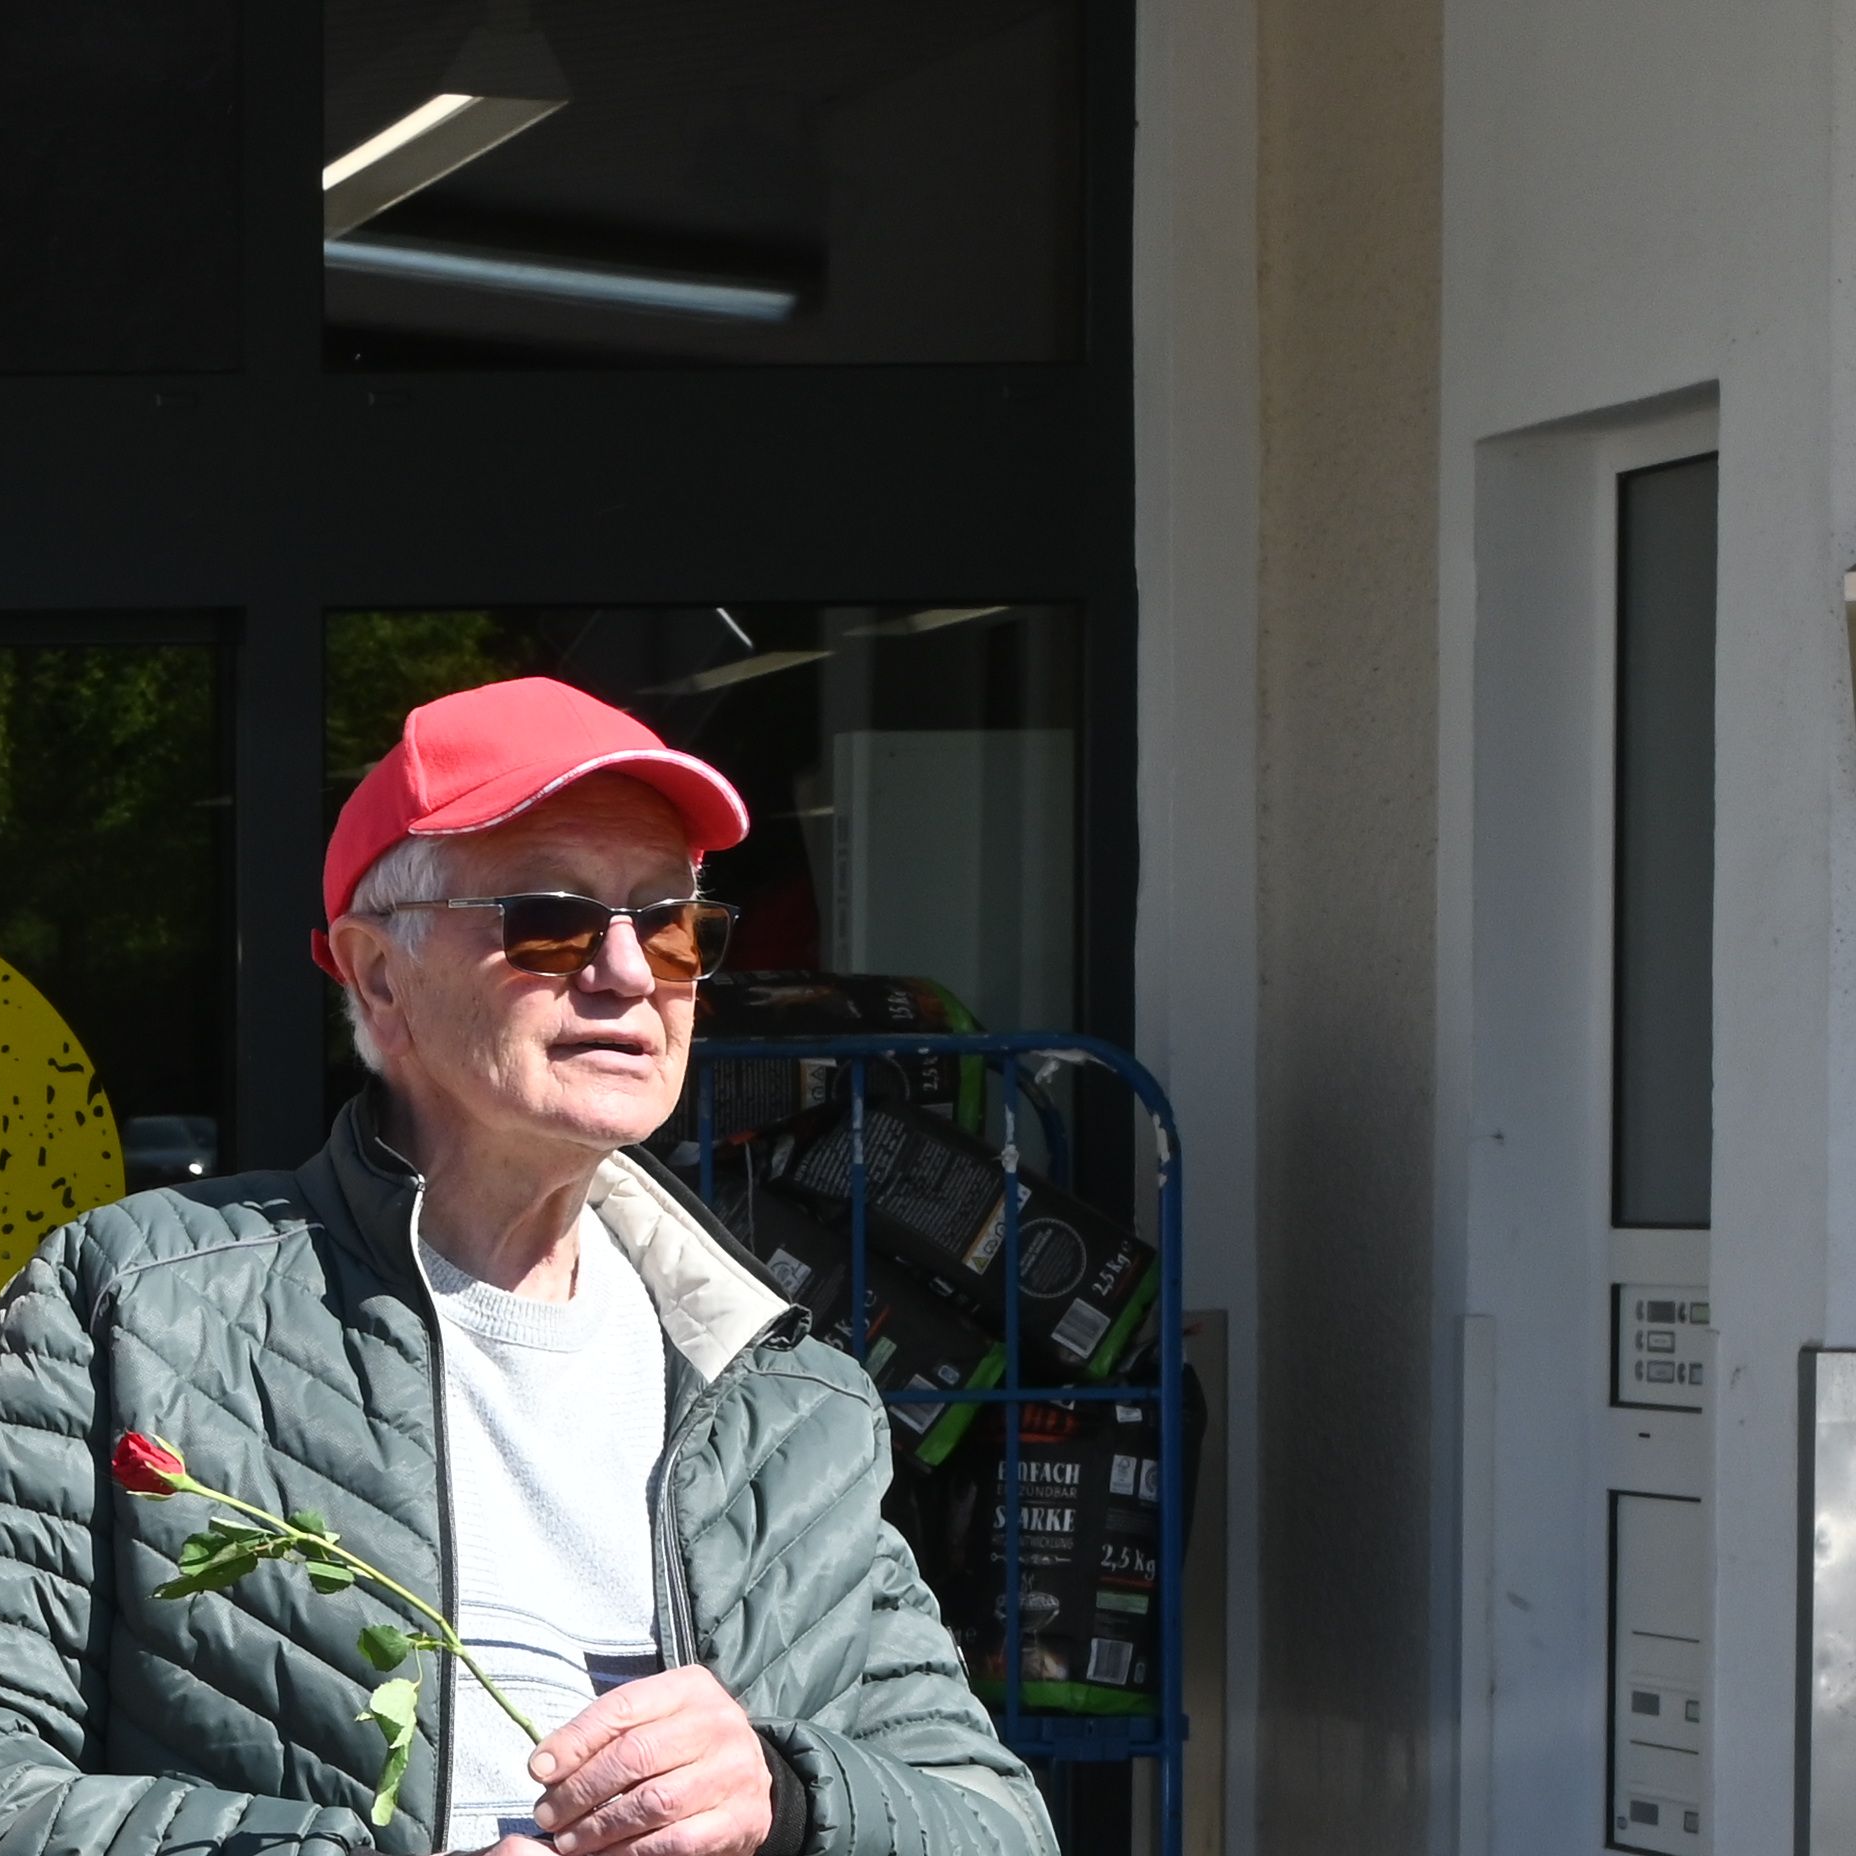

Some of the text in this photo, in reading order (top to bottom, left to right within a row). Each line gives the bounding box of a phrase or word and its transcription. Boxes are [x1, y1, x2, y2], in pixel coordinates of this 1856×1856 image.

[998, 1460, 1081, 1485] ENFACH
[993, 1504, 1076, 1533] SARKE
[1100, 1543, 1130, 1572] 2,5
